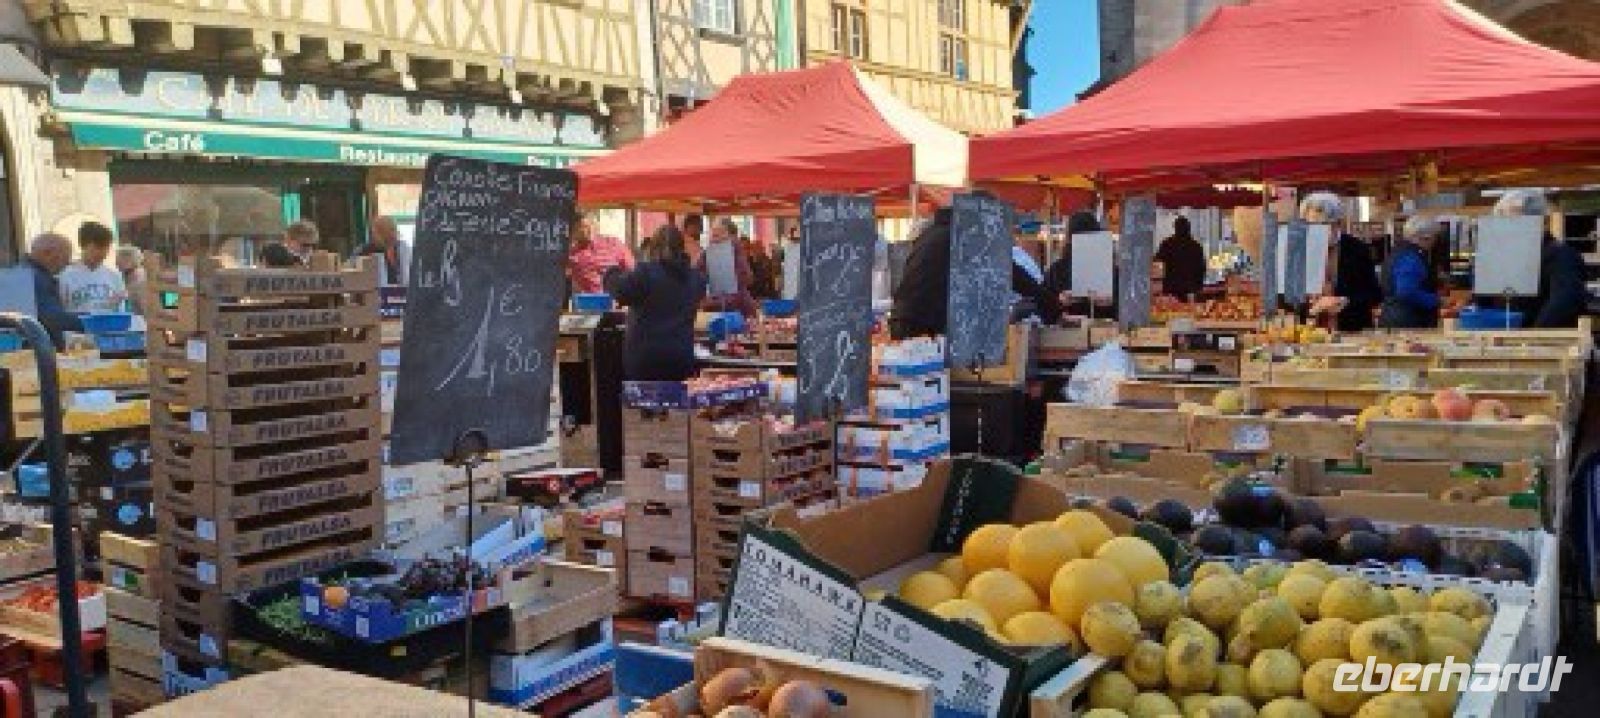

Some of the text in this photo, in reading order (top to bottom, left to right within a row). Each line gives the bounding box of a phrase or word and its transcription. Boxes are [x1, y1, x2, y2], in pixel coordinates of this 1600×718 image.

[142, 129, 205, 152] Café
[245, 277, 344, 291] FRUTALSA
[246, 312, 342, 329] FRUTALSA
[253, 349, 345, 368] FRUTALSA
[253, 380, 345, 401] FRUTALSA
[257, 415, 347, 439] FRUTALSA
[259, 449, 347, 475] FRUTALSA
[259, 481, 348, 511] FRUTALSA
[262, 517, 351, 548] FRUTALSA
